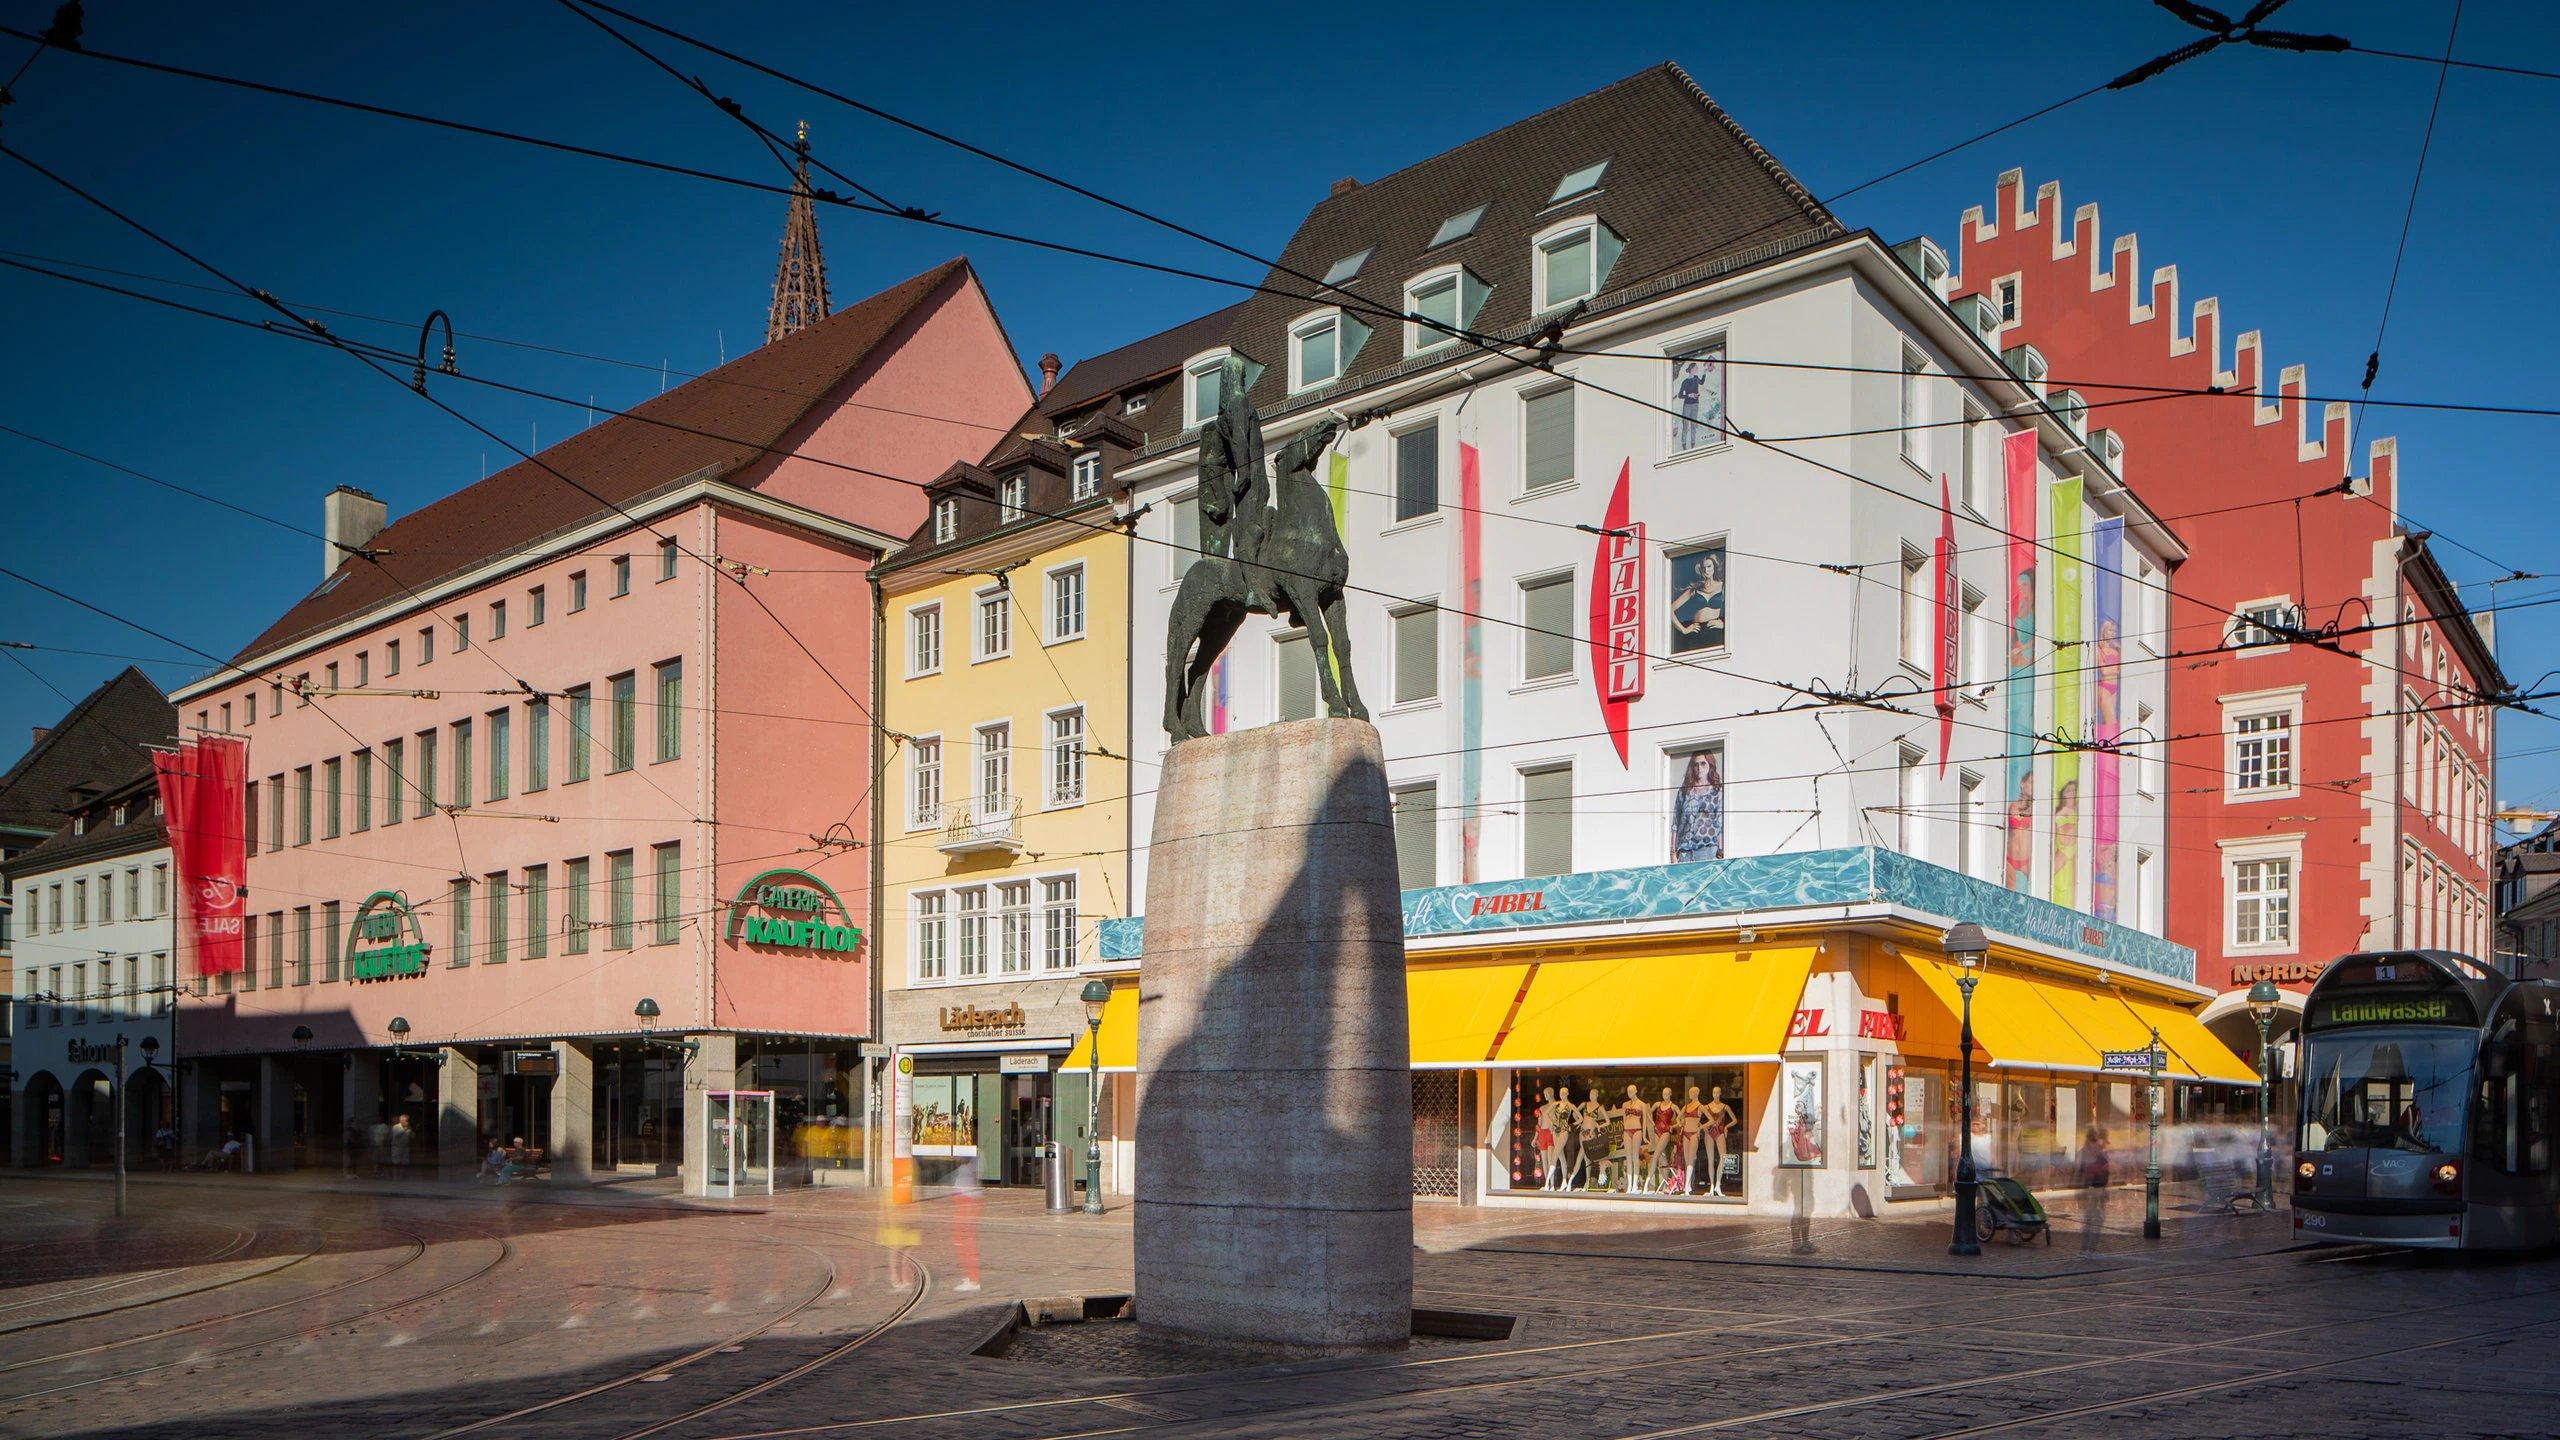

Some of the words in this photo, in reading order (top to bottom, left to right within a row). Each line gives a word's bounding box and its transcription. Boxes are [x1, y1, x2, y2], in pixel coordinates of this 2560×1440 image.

[1612, 528, 1637, 693] FABEL
[1945, 542, 1957, 707] FABEL
[757, 884, 820, 912] GALERIA
[1471, 891, 1547, 916] FABEL
[2026, 903, 2071, 948] fabelhaft
[2083, 926, 2105, 948] FABEL
[2233, 961, 2325, 983] NORDS
[2380, 966, 2389, 979] 1
[939, 1001, 1026, 1030] Läderach
[2331, 999, 2451, 1023] Landwasser
[967, 1029, 1003, 1038] chocolatier
[1004, 1028, 1026, 1036] suisse
[1858, 1010, 1907, 1041] FABEL
[1009, 1056, 1038, 1065] Läderach
[2382, 1160, 2406, 1168] VAG
[2304, 1214, 2326, 1227] 290
